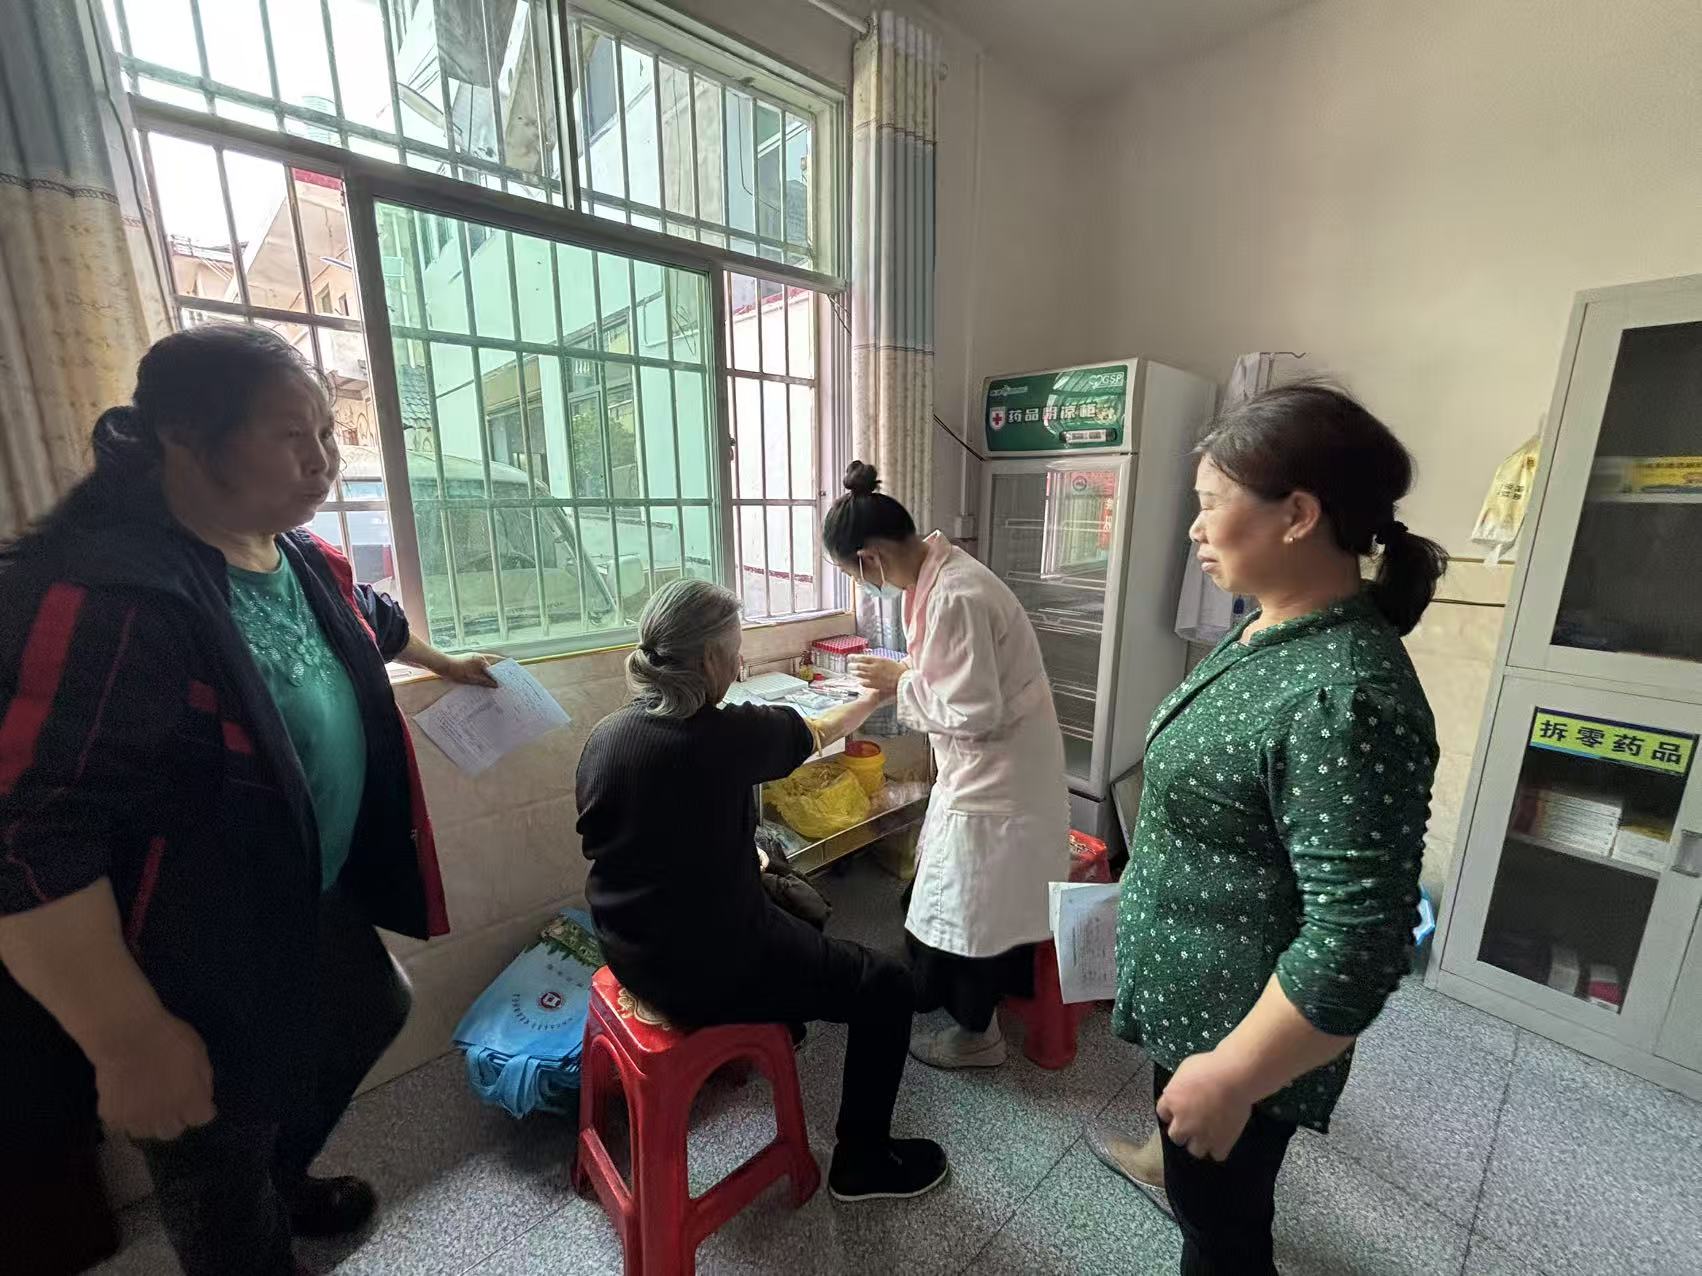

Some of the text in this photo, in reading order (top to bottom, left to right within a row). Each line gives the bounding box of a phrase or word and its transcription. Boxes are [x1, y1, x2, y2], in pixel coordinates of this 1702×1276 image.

[1103, 373, 1123, 384] GSP
[1540, 719, 1682, 765] 拆零药品
